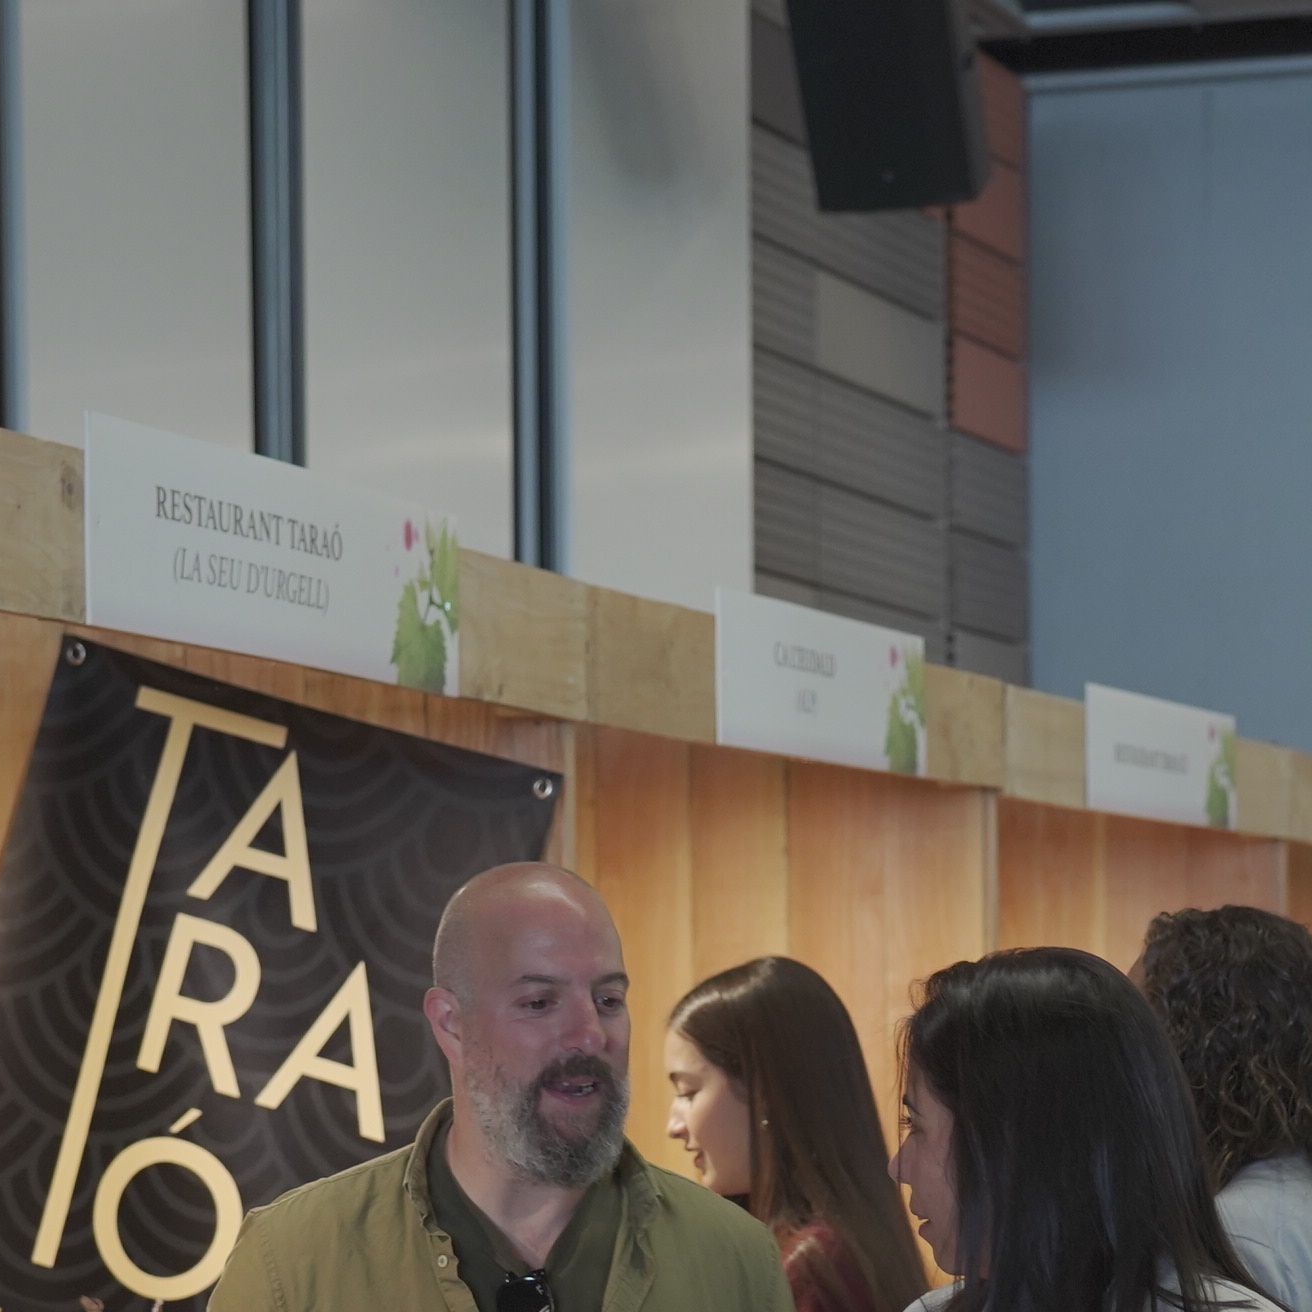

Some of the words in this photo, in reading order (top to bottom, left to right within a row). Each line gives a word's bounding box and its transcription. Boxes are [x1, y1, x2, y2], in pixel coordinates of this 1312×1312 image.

[155, 485, 284, 546] RESTAURANT
[288, 518, 344, 562] TARAÓ
[173, 546, 203, 584] (LA
[207, 553, 243, 591] SEU
[246, 562, 331, 616] D'URGELL)
